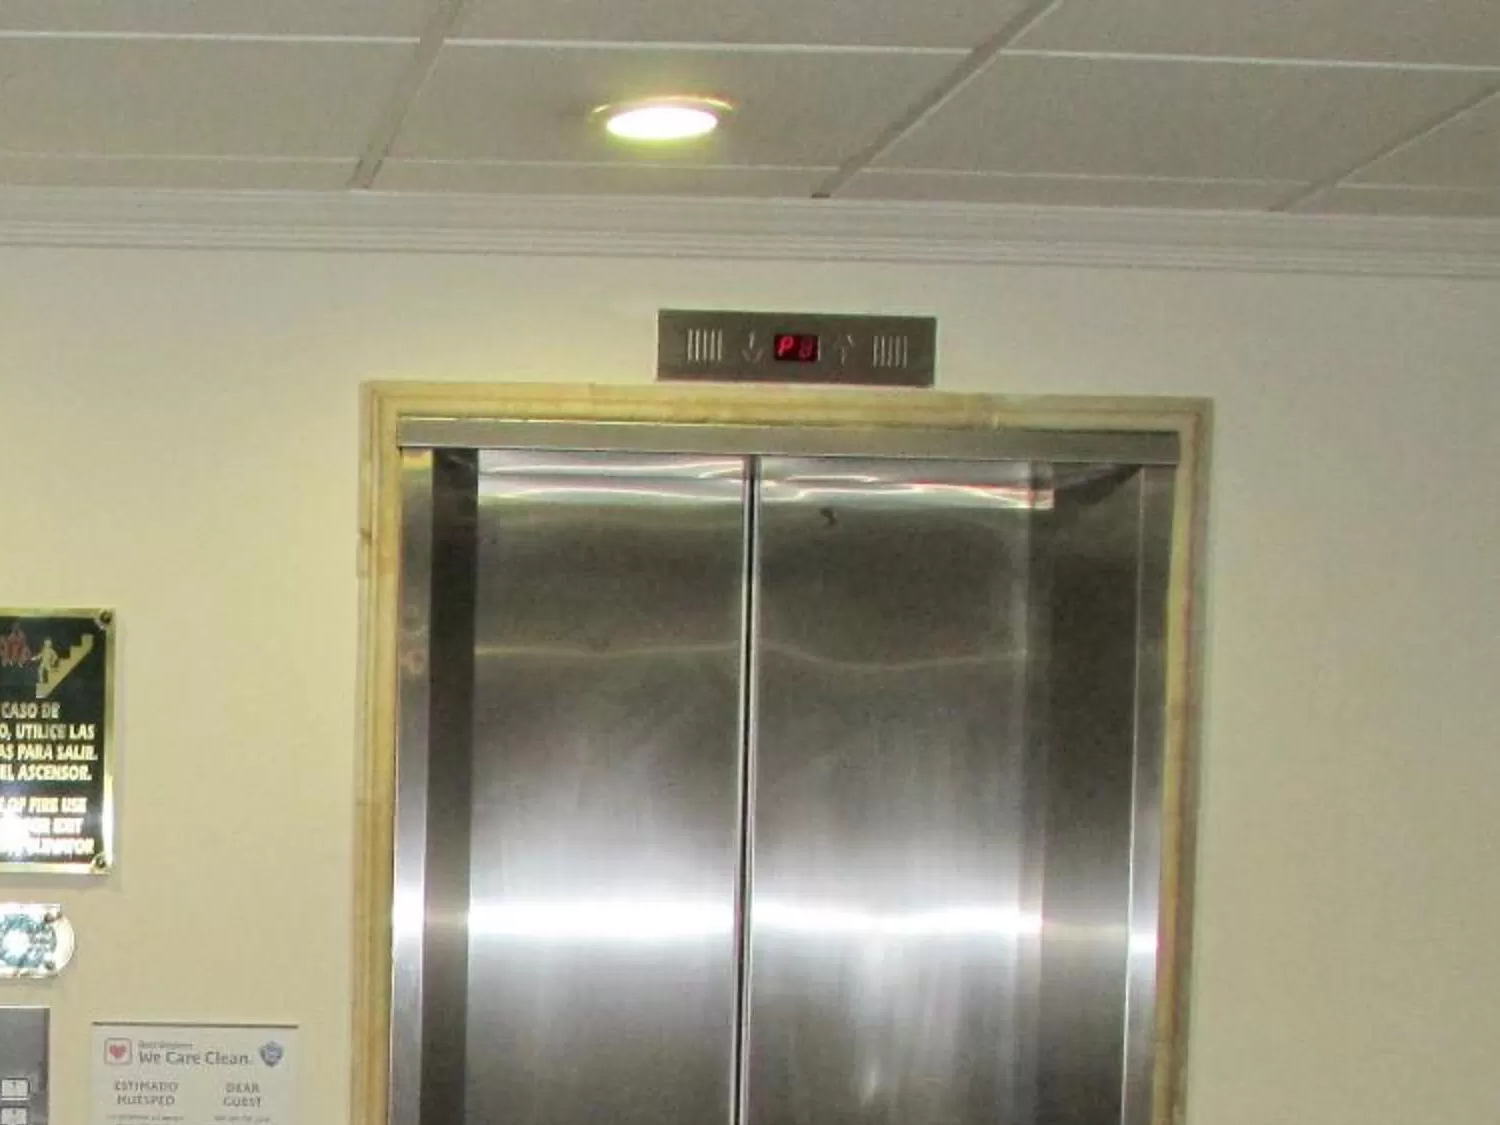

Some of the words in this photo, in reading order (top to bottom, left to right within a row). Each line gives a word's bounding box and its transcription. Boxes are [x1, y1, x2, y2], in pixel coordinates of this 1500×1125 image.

[1, 702, 37, 719] CASO
[41, 702, 60, 718] DE
[16, 723, 66, 740] UTILICE
[69, 724, 95, 740] LAS
[17, 744, 52, 761] PARA
[56, 744, 98, 761] SALIR.
[0, 764, 15, 780] EL
[17, 764, 93, 781] ASCENSOR.
[28, 797, 59, 813] FIRE
[61, 797, 87, 813] USE
[138, 1052, 161, 1064] We
[165, 1051, 200, 1065] Care
[115, 1080, 179, 1092] ESTIMADO
[226, 1082, 260, 1093] DEAR
[223, 1096, 261, 1108] GUEST
